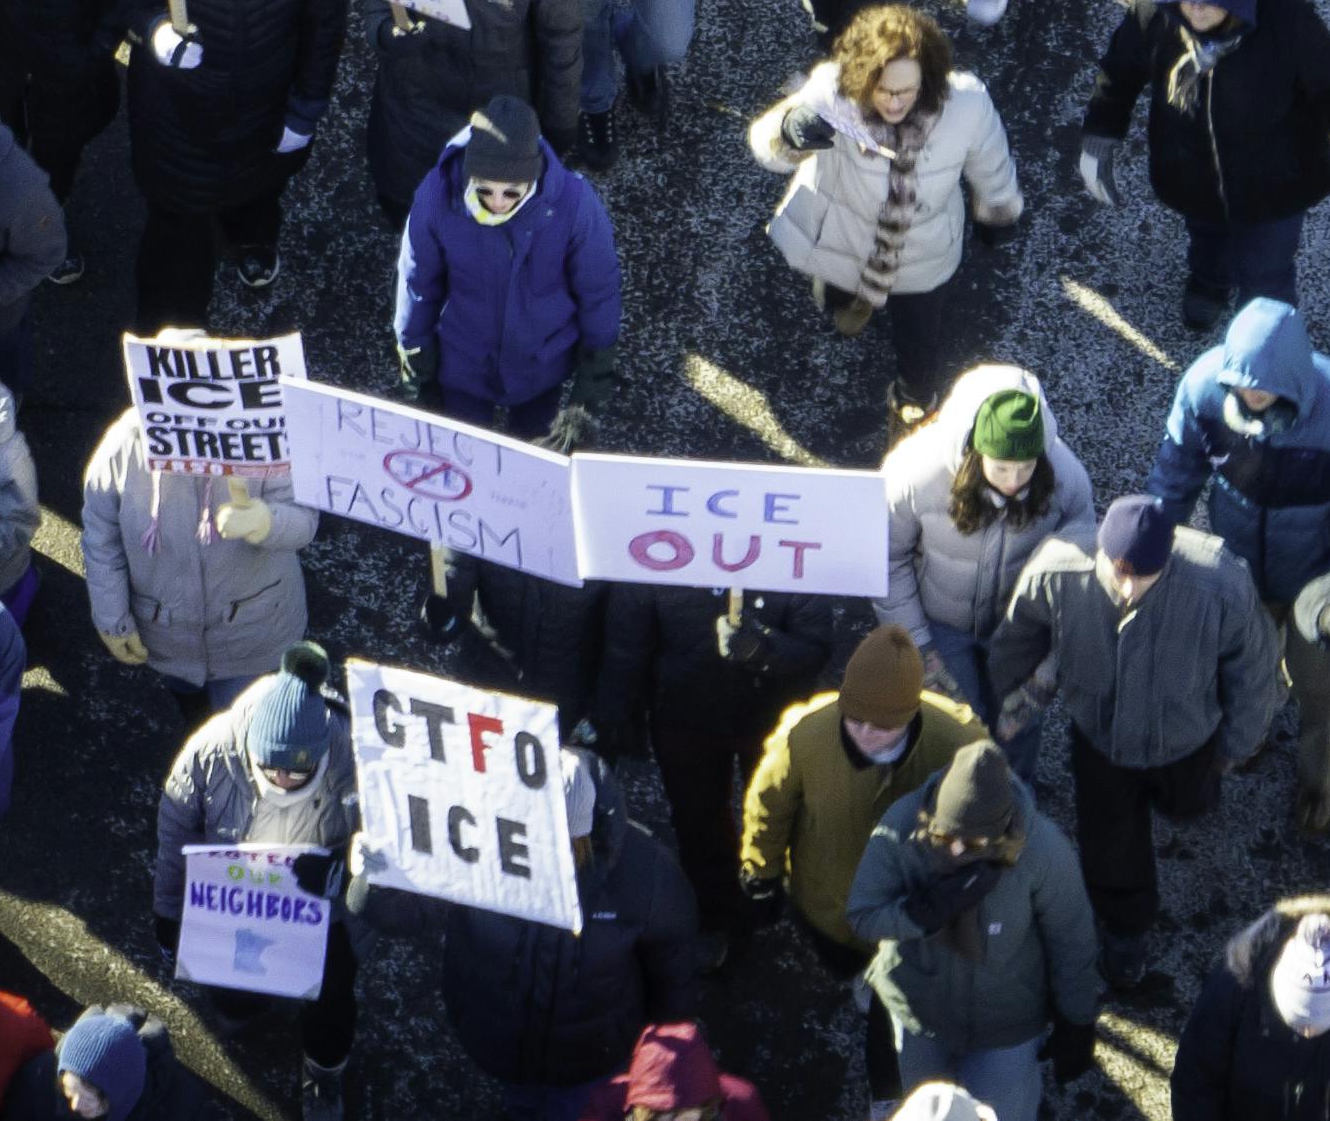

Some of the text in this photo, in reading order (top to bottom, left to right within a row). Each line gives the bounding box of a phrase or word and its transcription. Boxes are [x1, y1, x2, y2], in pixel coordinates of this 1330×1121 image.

[146, 345, 281, 380] KILLER
[138, 378, 283, 410] ICE
[146, 411, 218, 427] OFF
[337, 397, 504, 476] REJECT
[326, 474, 523, 567] FASCISM
[646, 484, 801, 524] ICE
[628, 529, 822, 578] OUT
[373, 689, 547, 790] GTFO
[408, 794, 532, 880] ICE
[190, 881, 323, 925] NEIGHBORS
